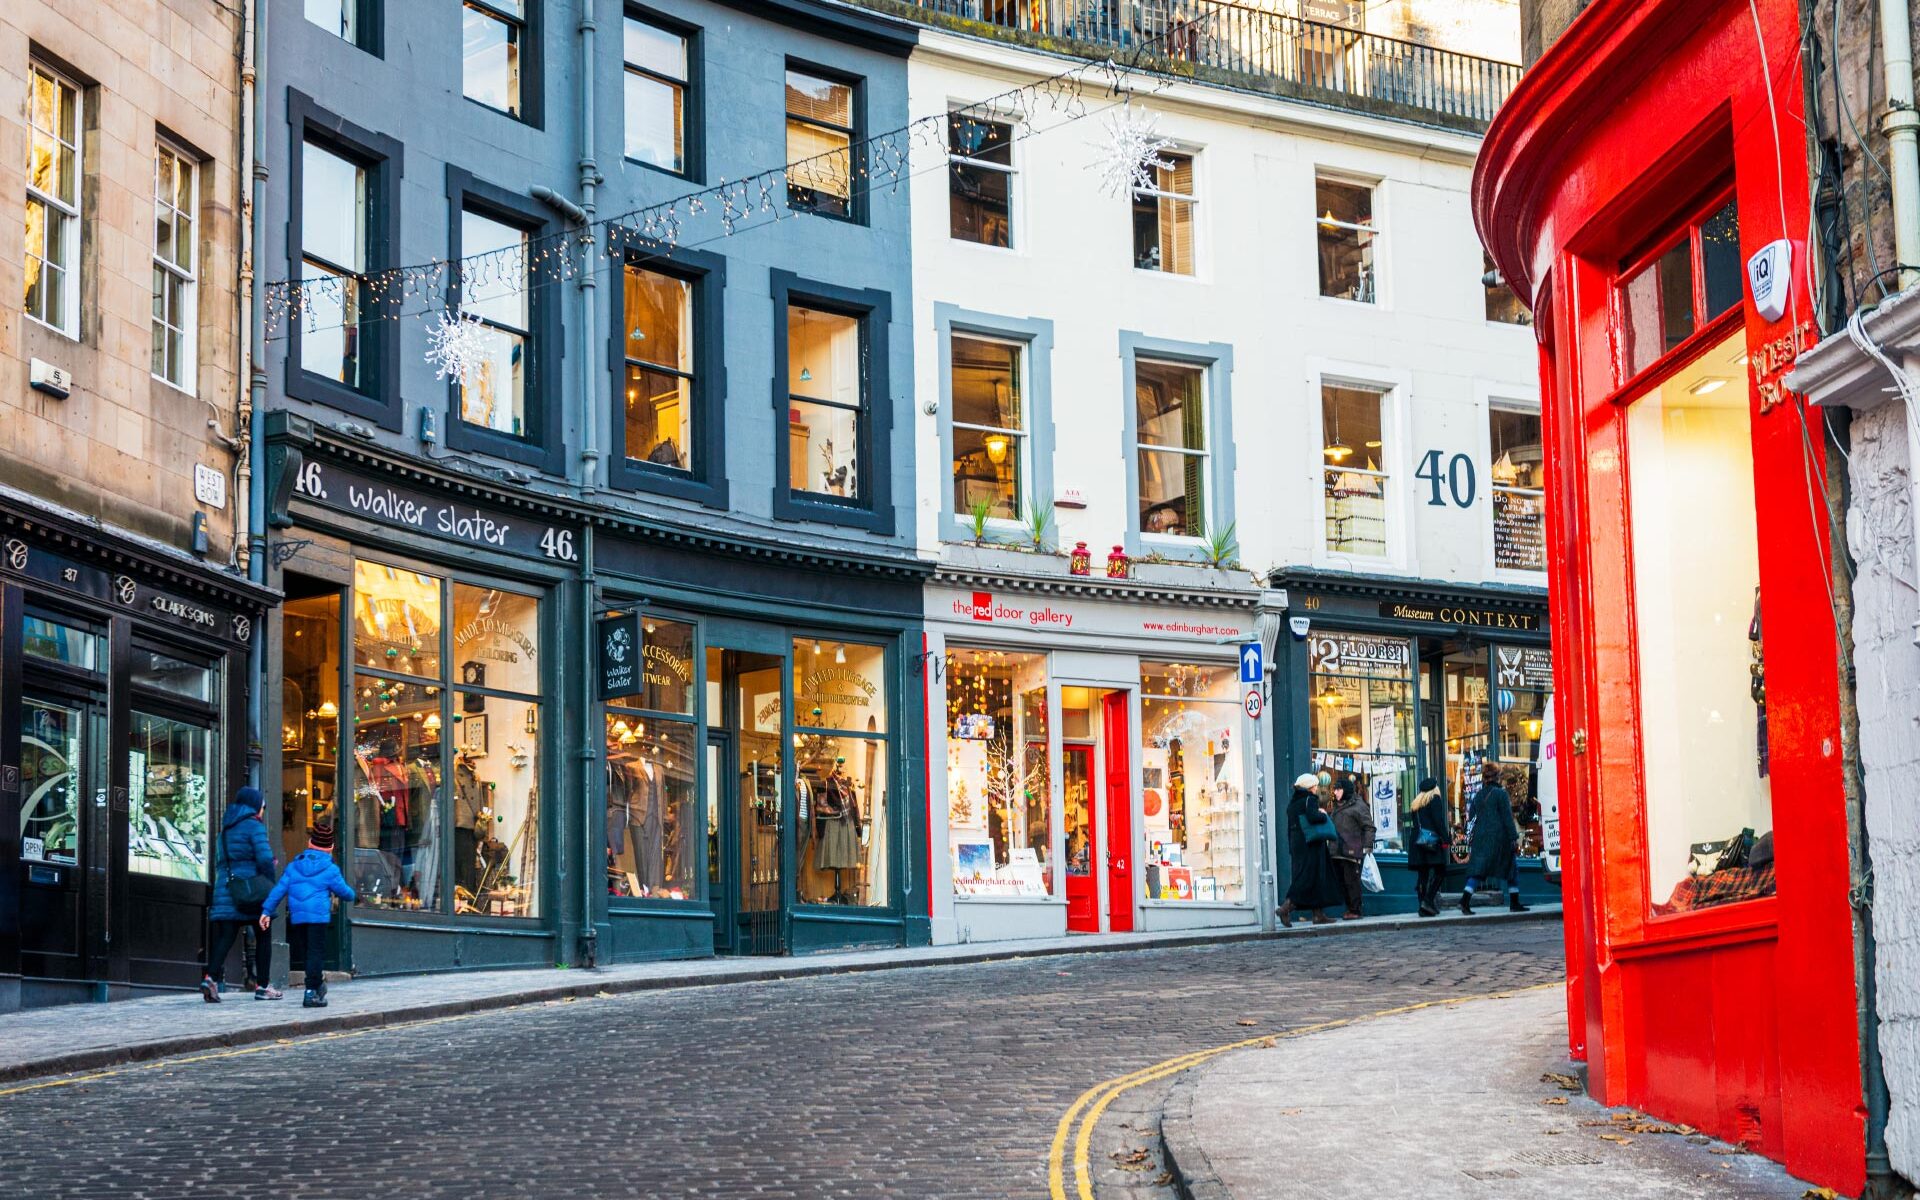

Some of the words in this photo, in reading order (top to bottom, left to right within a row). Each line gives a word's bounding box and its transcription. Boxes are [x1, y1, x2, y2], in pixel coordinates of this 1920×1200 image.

[1303, 5, 1340, 21] TERRACE
[1756, 258, 1769, 282] iQ
[1752, 321, 1810, 384] WEST
[1758, 375, 1788, 415] BO
[1414, 449, 1476, 509] 40
[539, 527, 579, 562] 46.
[153, 596, 215, 627] CLARKSONS
[1304, 595, 1320, 610] 40
[952, 599, 972, 615] the
[973, 601, 992, 617] red
[994, 603, 1024, 619] door
[1029, 607, 1073, 627] gallery
[1393, 604, 1435, 621] Museum
[1440, 607, 1532, 630] CONTEXT
[481, 618, 494, 632] TO
[1143, 621, 1239, 636] www.edinburghart.com
[1340, 640, 1402, 661] FLOORS!
[647, 660, 654, 669] &
[1247, 698, 1259, 711] 20
[24, 841, 42, 853] OPEN
[1450, 845, 1471, 853] COFFE
[1116, 858, 1125, 870] 42
